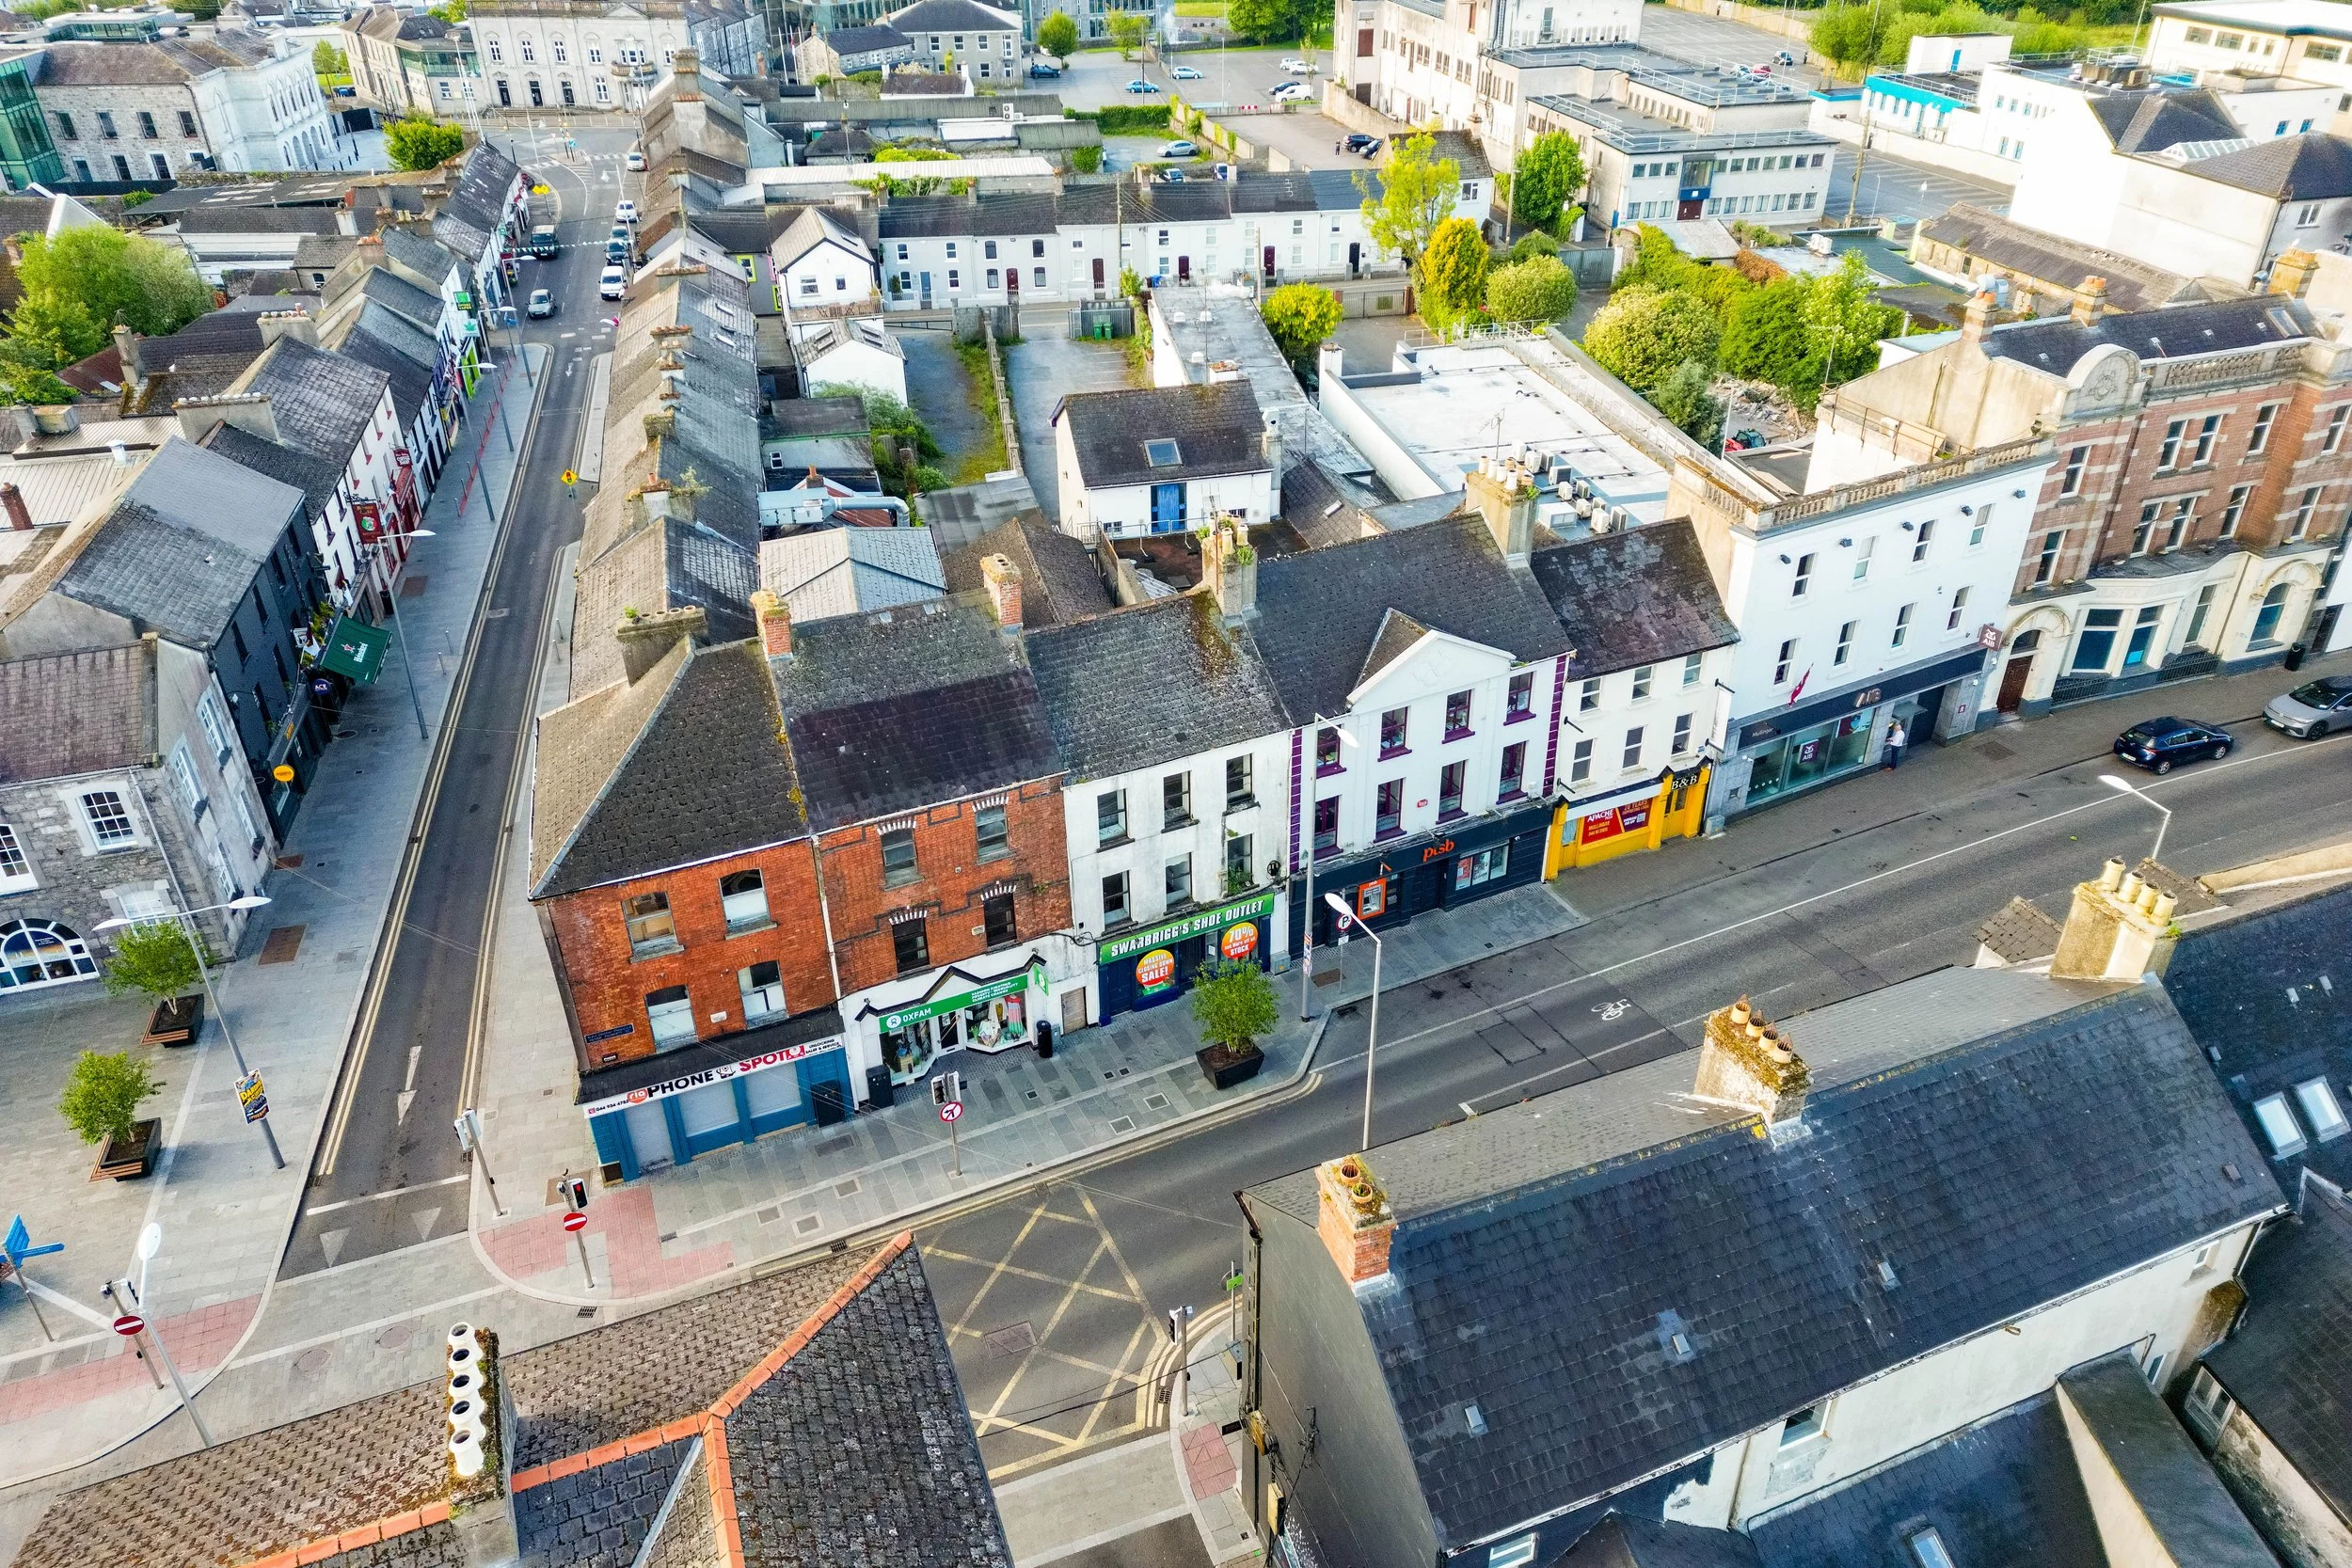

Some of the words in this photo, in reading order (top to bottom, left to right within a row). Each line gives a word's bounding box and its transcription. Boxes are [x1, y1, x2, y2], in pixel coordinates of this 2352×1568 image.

[1982, 638, 1995, 647] AIB
[1855, 688, 1882, 707] AIB
[1752, 727, 1773, 737] Mullingar
[1671, 775, 1697, 790] B&B
[1587, 809, 1614, 822] APACHE
[1422, 838, 1454, 863] ptsb
[1110, 923, 1190, 958] SWARBRIGG'S
[1193, 912, 1222, 931] SHOE
[1225, 900, 1265, 922] OUTLET
[1229, 926, 1254, 942] 70%
[1230, 944, 1249, 956] STOCK
[1143, 953, 1167, 965] MASSIVE
[1141, 966, 1168, 983] SALE!
[902, 1007, 931, 1022] OXFAM
[646, 1069, 714, 1098] PHONE
[739, 1048, 789, 1072] SPOT
[629, 1090, 644, 1100] ria
